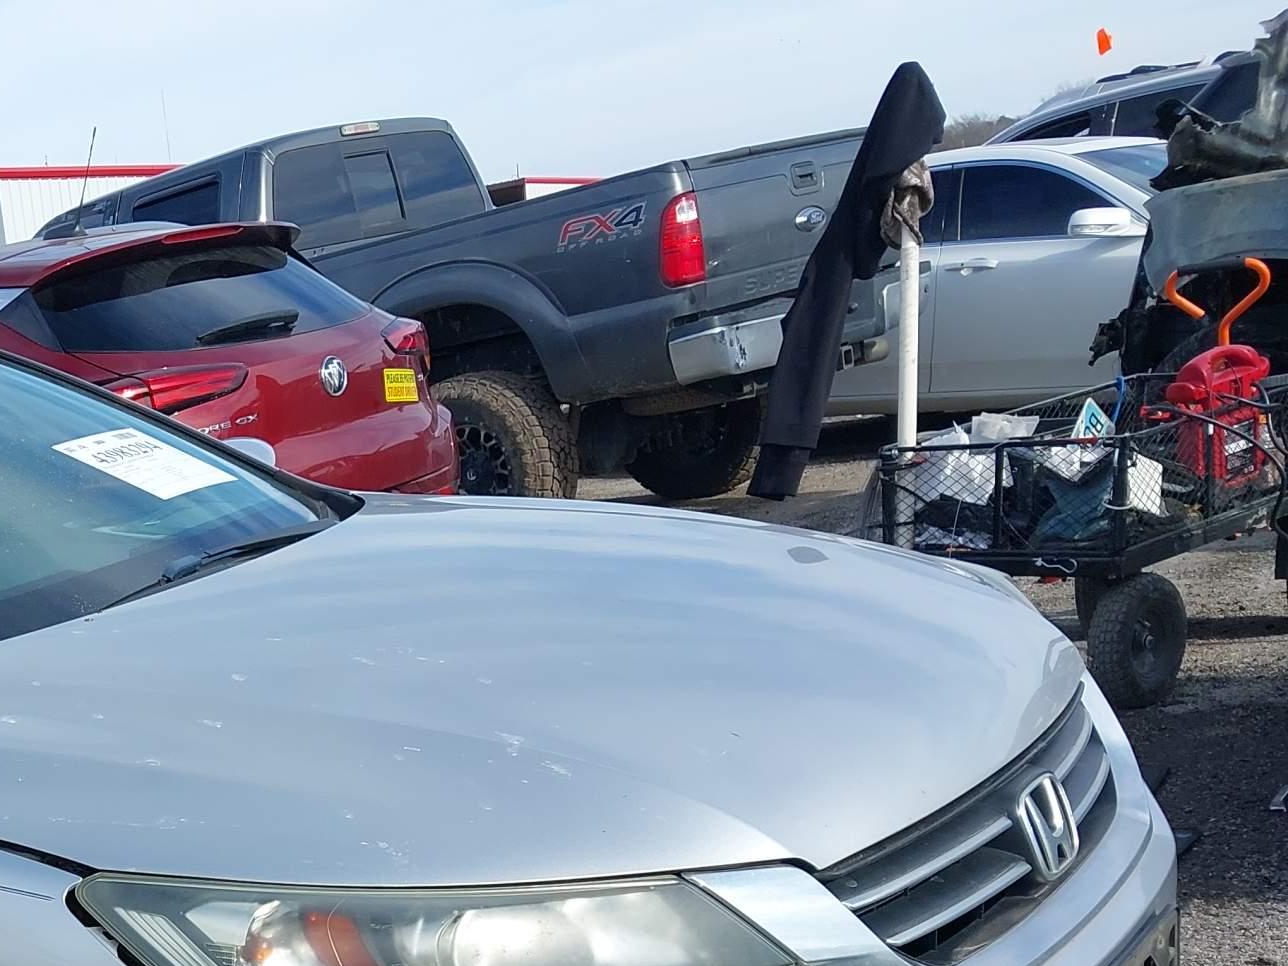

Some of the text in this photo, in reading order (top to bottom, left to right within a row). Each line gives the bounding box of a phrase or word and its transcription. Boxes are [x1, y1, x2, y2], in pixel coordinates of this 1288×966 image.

[558, 201, 647, 247] FX4
[744, 265, 799, 295] SUPE
[197, 412, 259, 435] ORE GX
[91, 440, 164, 465] 43983294
